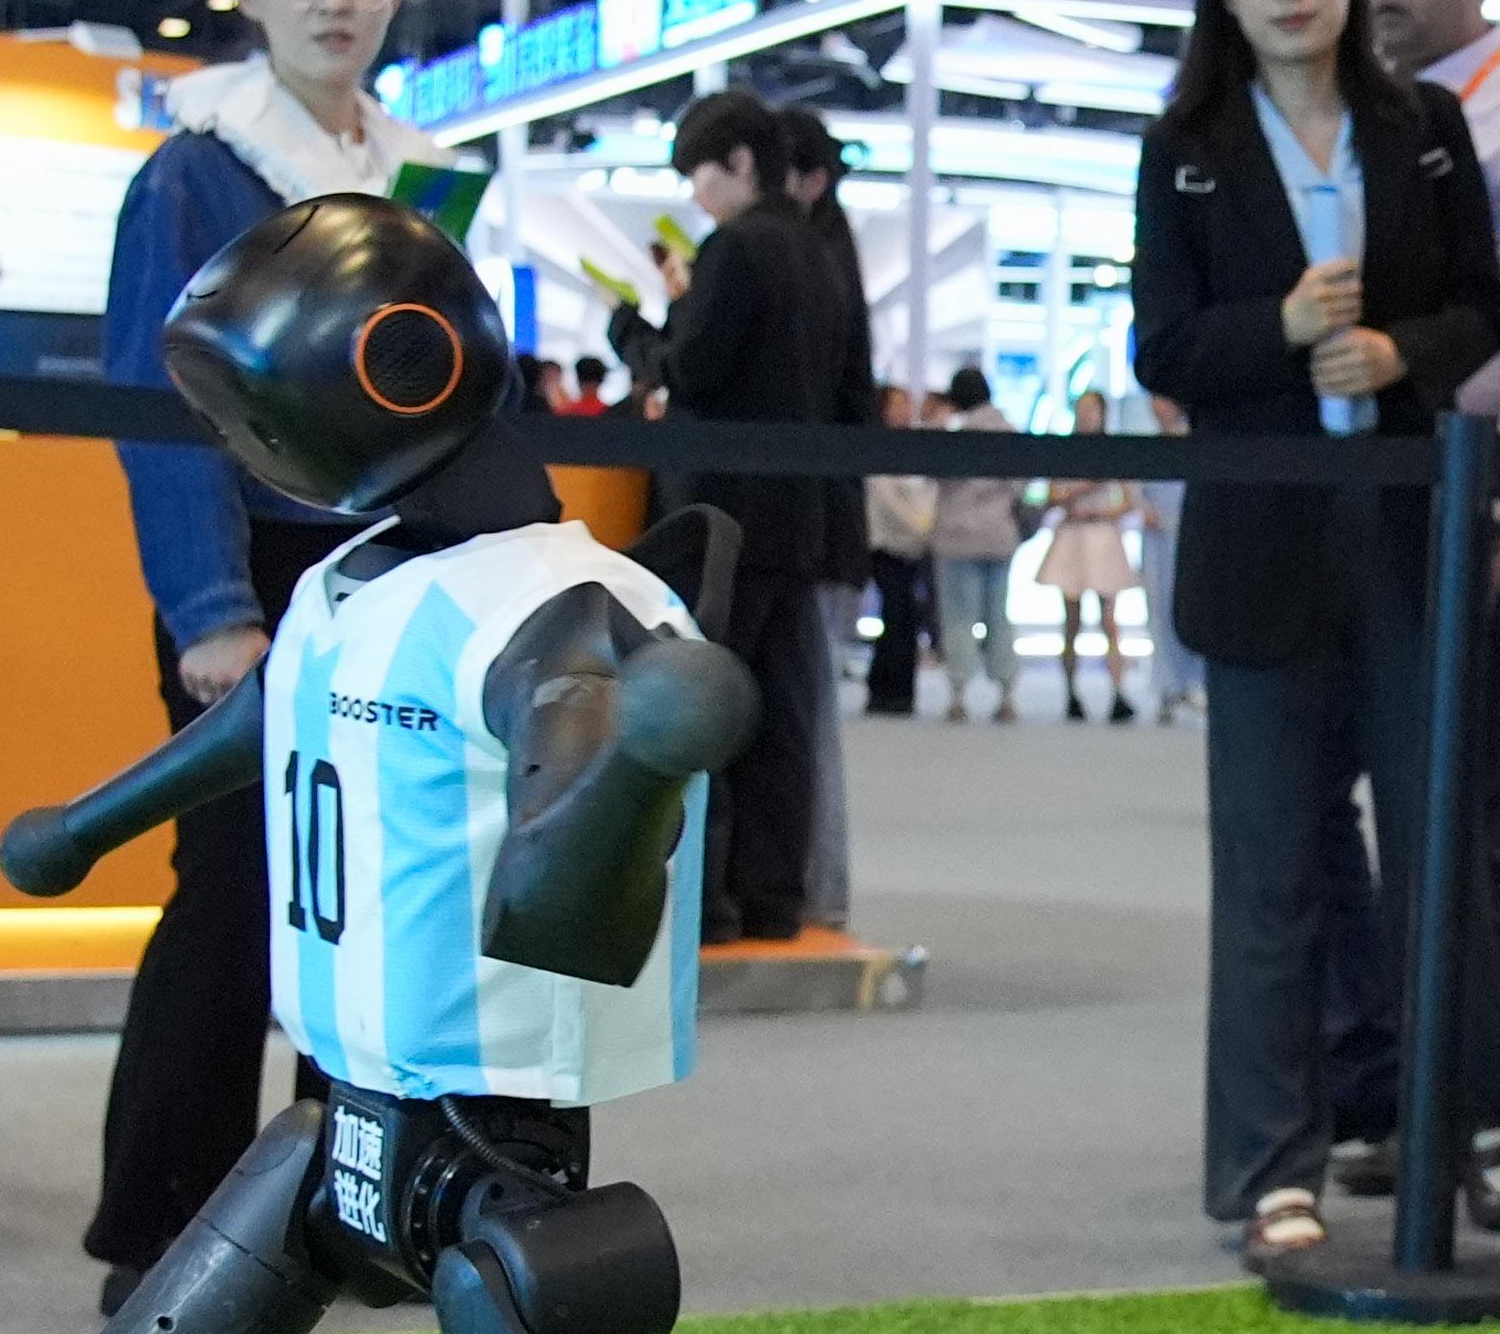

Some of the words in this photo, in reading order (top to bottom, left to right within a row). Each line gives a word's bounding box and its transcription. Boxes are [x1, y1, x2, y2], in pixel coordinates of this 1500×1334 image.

[330, 692, 438, 731] BOOSTER
[285, 749, 345, 946] 10
[331, 1105, 384, 1181] 加速
[334, 1169, 387, 1243] 进化
